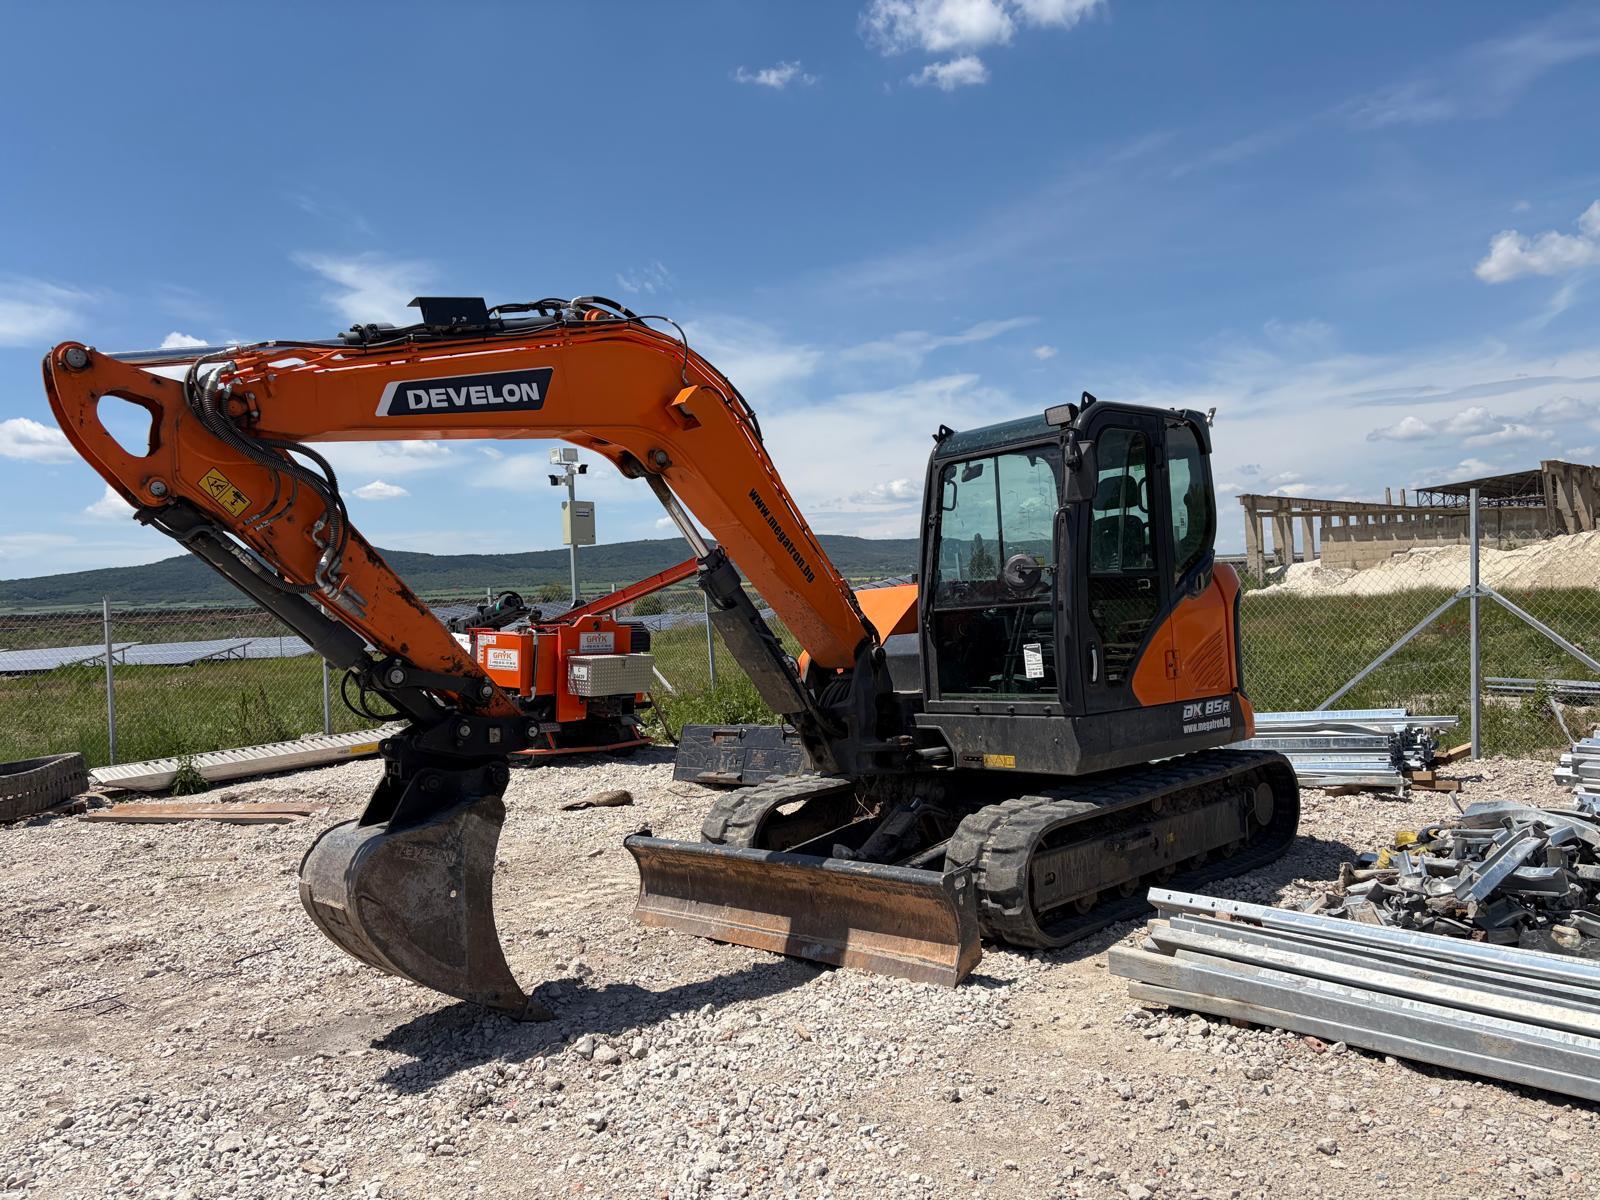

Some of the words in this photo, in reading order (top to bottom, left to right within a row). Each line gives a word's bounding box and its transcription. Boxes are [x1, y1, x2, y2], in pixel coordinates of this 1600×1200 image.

[406, 383, 540, 410] DEVELON
[748, 488, 816, 584] www.megatron.bg
[1205, 699, 1231, 717] 85R
[1183, 716, 1231, 734] www.megatron.bg
